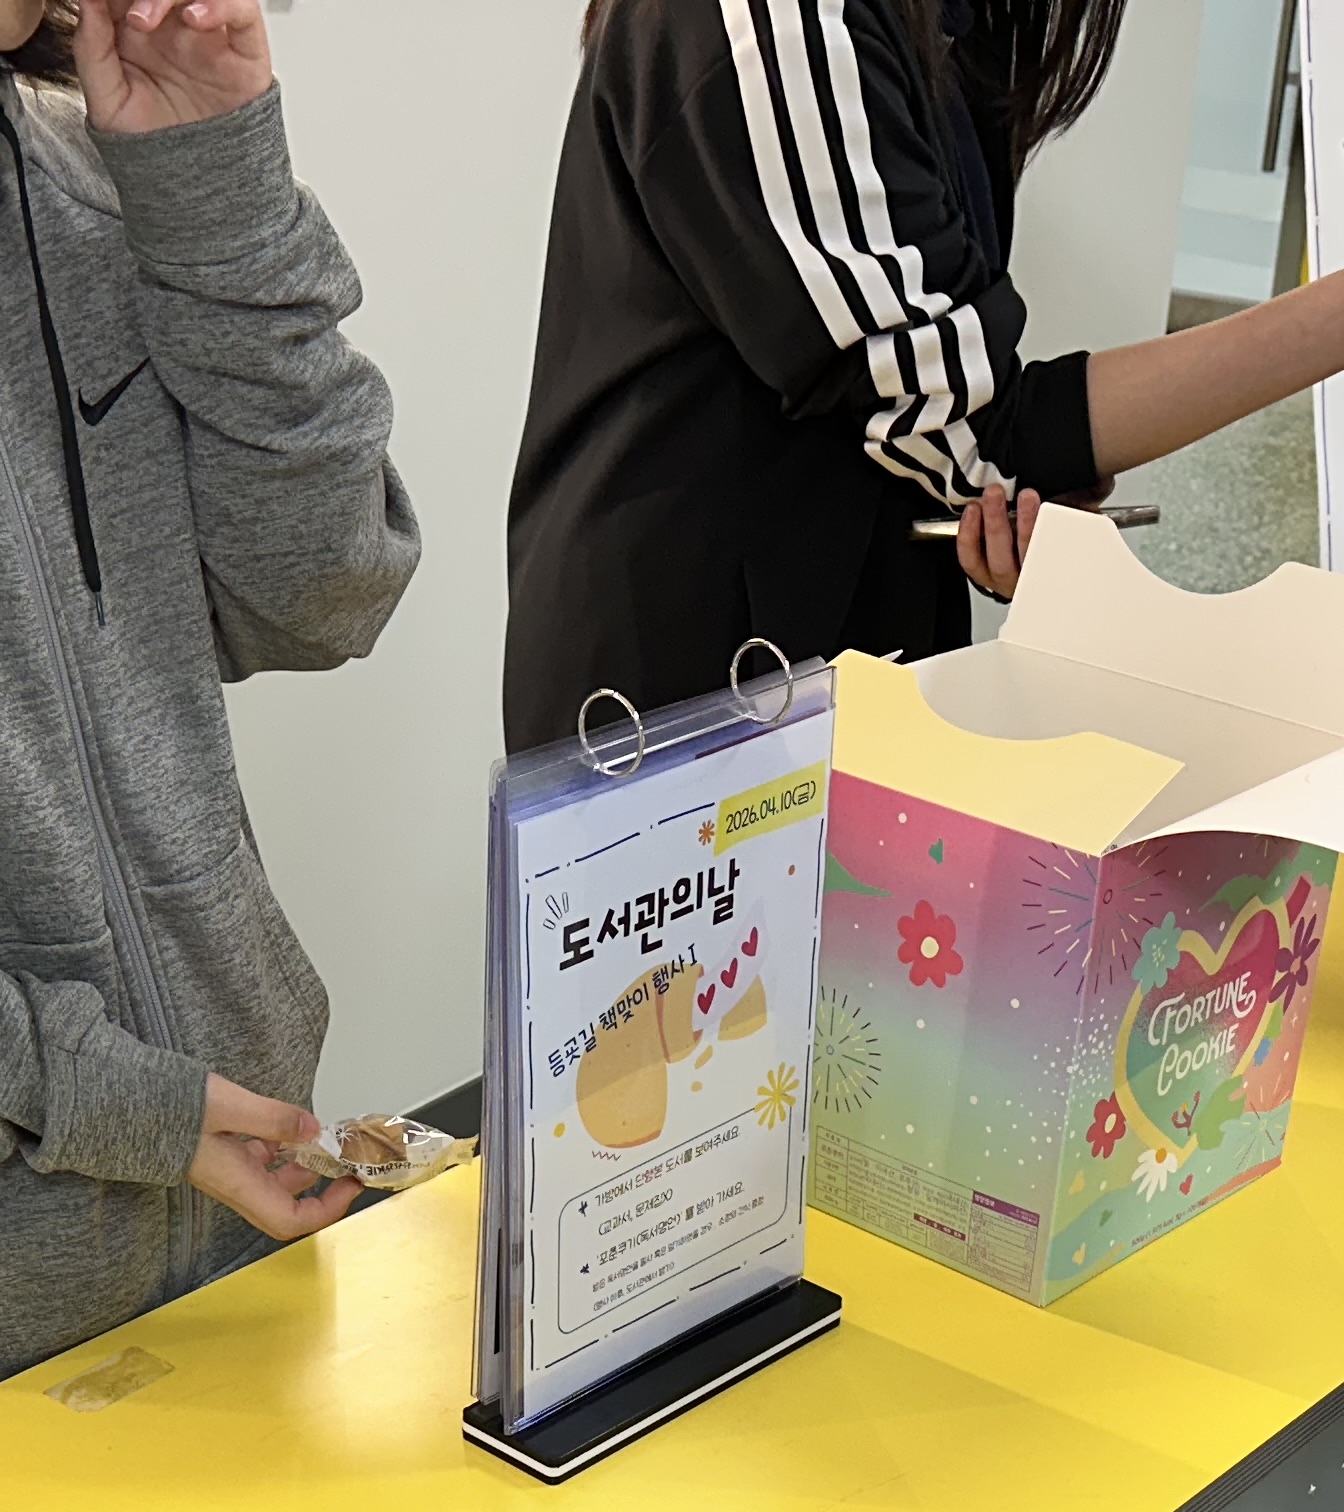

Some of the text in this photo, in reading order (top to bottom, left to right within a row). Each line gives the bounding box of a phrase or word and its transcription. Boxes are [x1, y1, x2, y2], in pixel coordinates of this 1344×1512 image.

[725, 779, 816, 834] 2026.04.10(금)
[559, 857, 741, 971] 도서관의날
[547, 942, 698, 1078] 등굣길 책맞이 행사 I
[1148, 971, 1257, 1046] FORTUNE
[1157, 1023, 1239, 1096] COOKIE
